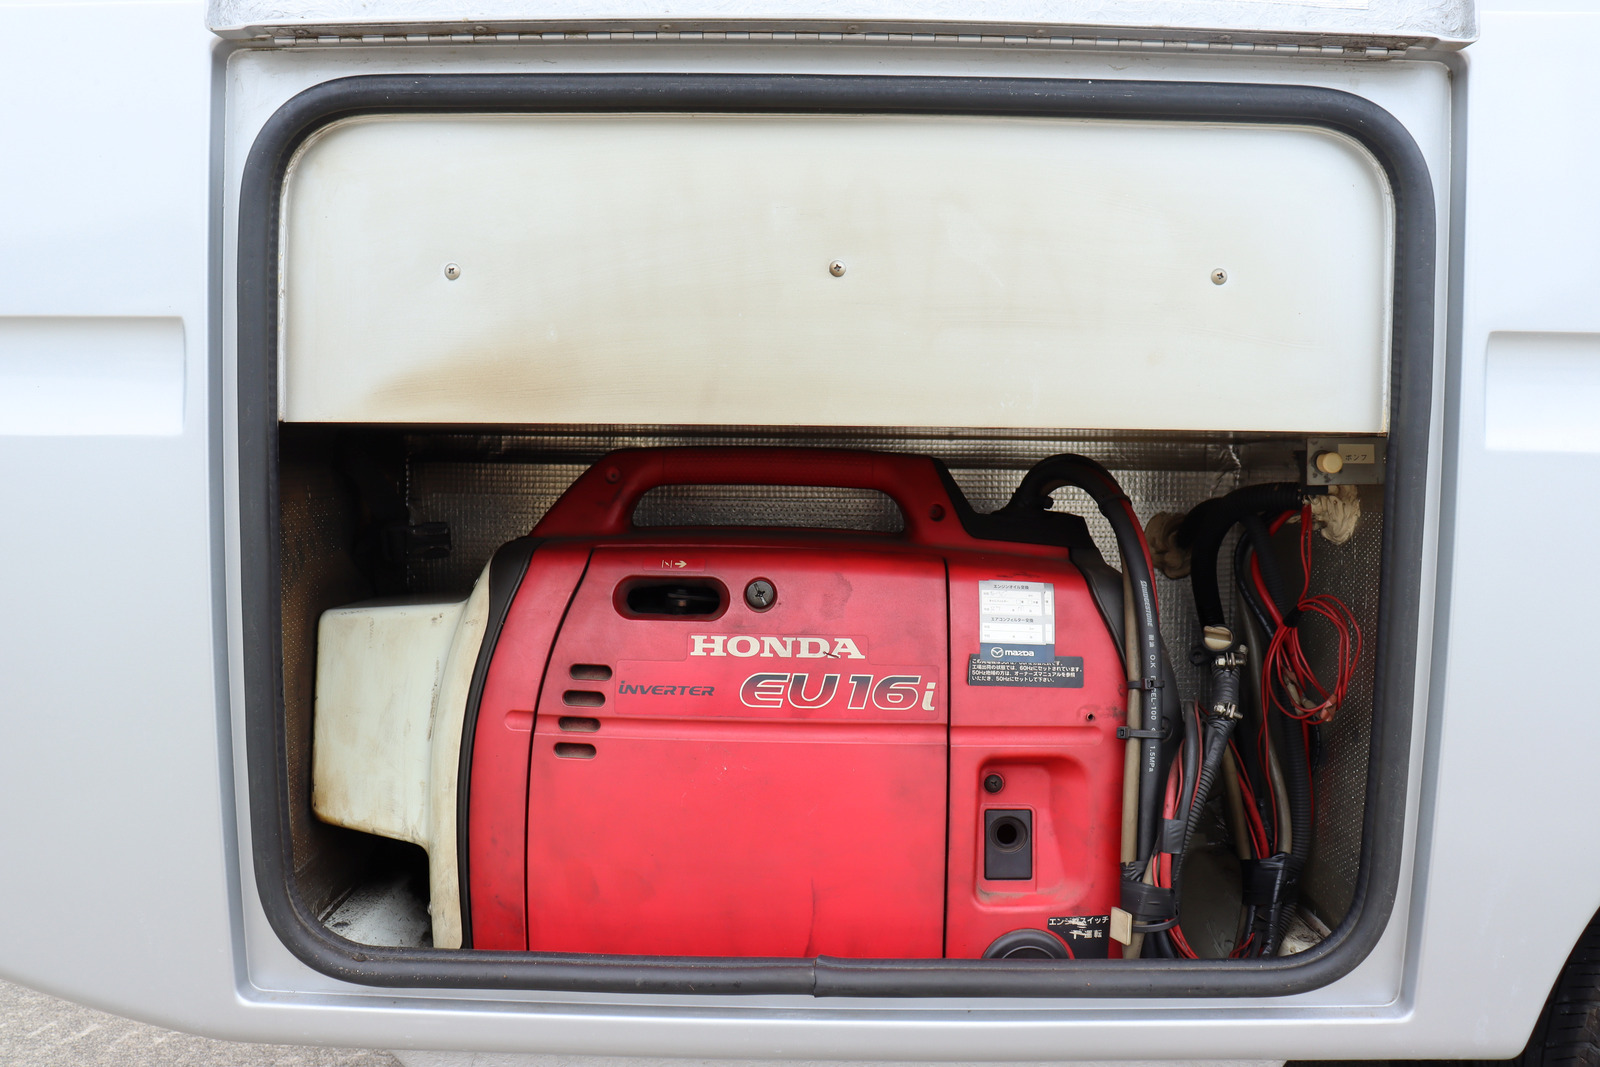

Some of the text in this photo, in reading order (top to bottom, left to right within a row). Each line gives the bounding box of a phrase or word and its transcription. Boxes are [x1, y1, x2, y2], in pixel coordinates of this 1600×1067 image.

[1140, 580, 1153, 628] BRIDGESTONE
[690, 635, 866, 659] HONDA
[1004, 649, 1035, 657] mazda
